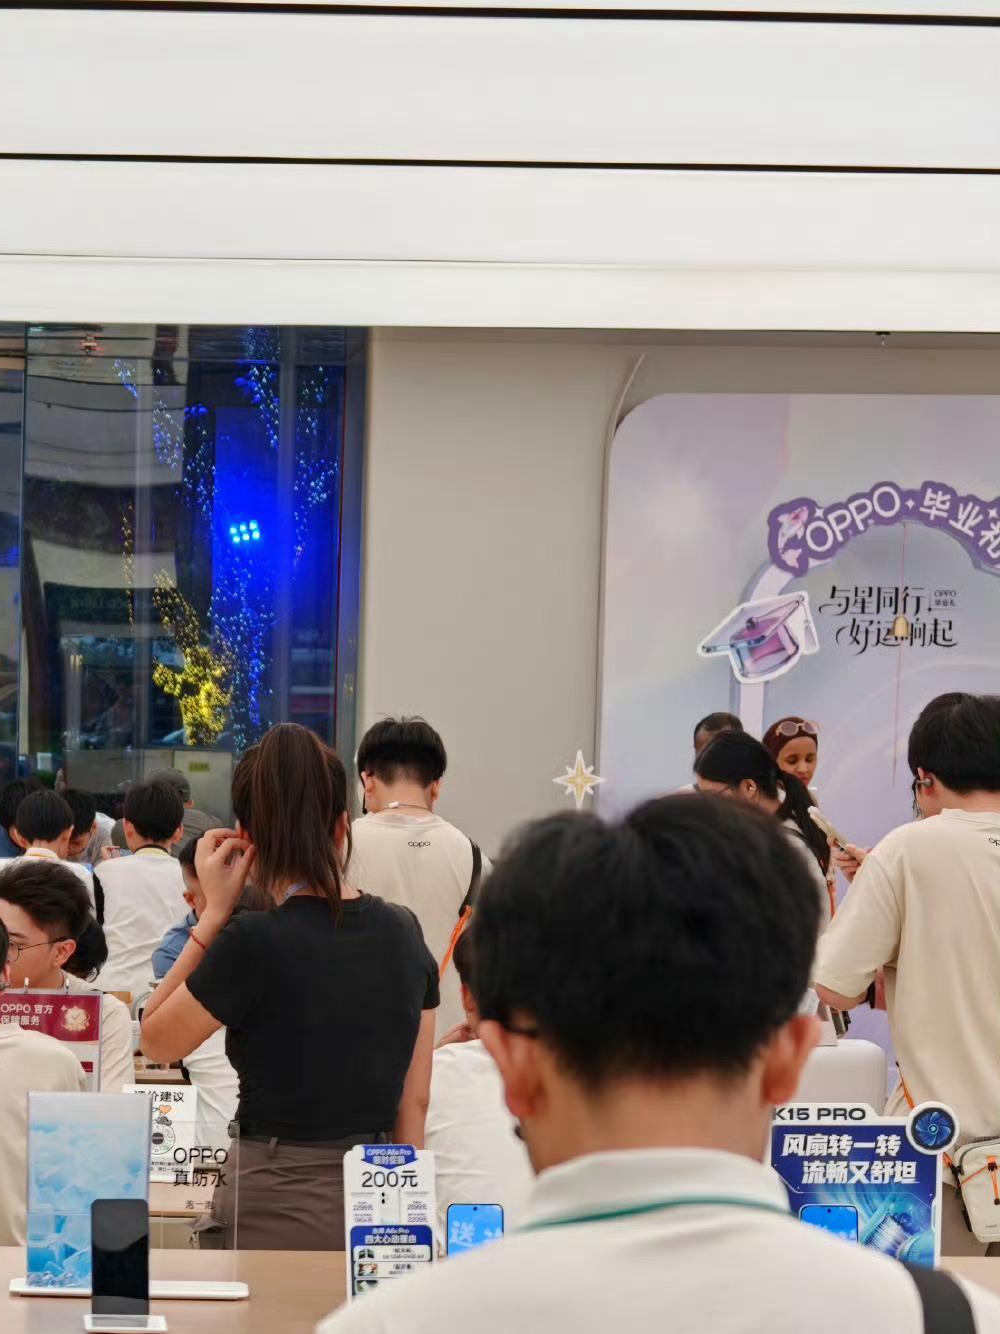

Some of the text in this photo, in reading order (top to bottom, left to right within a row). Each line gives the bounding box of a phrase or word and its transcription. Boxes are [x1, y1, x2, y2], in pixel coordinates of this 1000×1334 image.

[805, 486, 900, 552] OPPO
[818, 585, 925, 616] 与星同行
[408, 840, 431, 848] oppo
[0, 1003, 54, 1014] OPPO 官方
[1, 1014, 41, 1026] 保障服务
[134, 1091, 185, 1103] 价建议
[773, 1107, 866, 1121] K15 PRO
[780, 1133, 902, 1158] 风扇转一转
[173, 1147, 229, 1165] OPPO
[173, 1168, 229, 1187] 真防水
[361, 1170, 418, 1188] 200元
[801, 1160, 920, 1185] 流畅又舒坦
